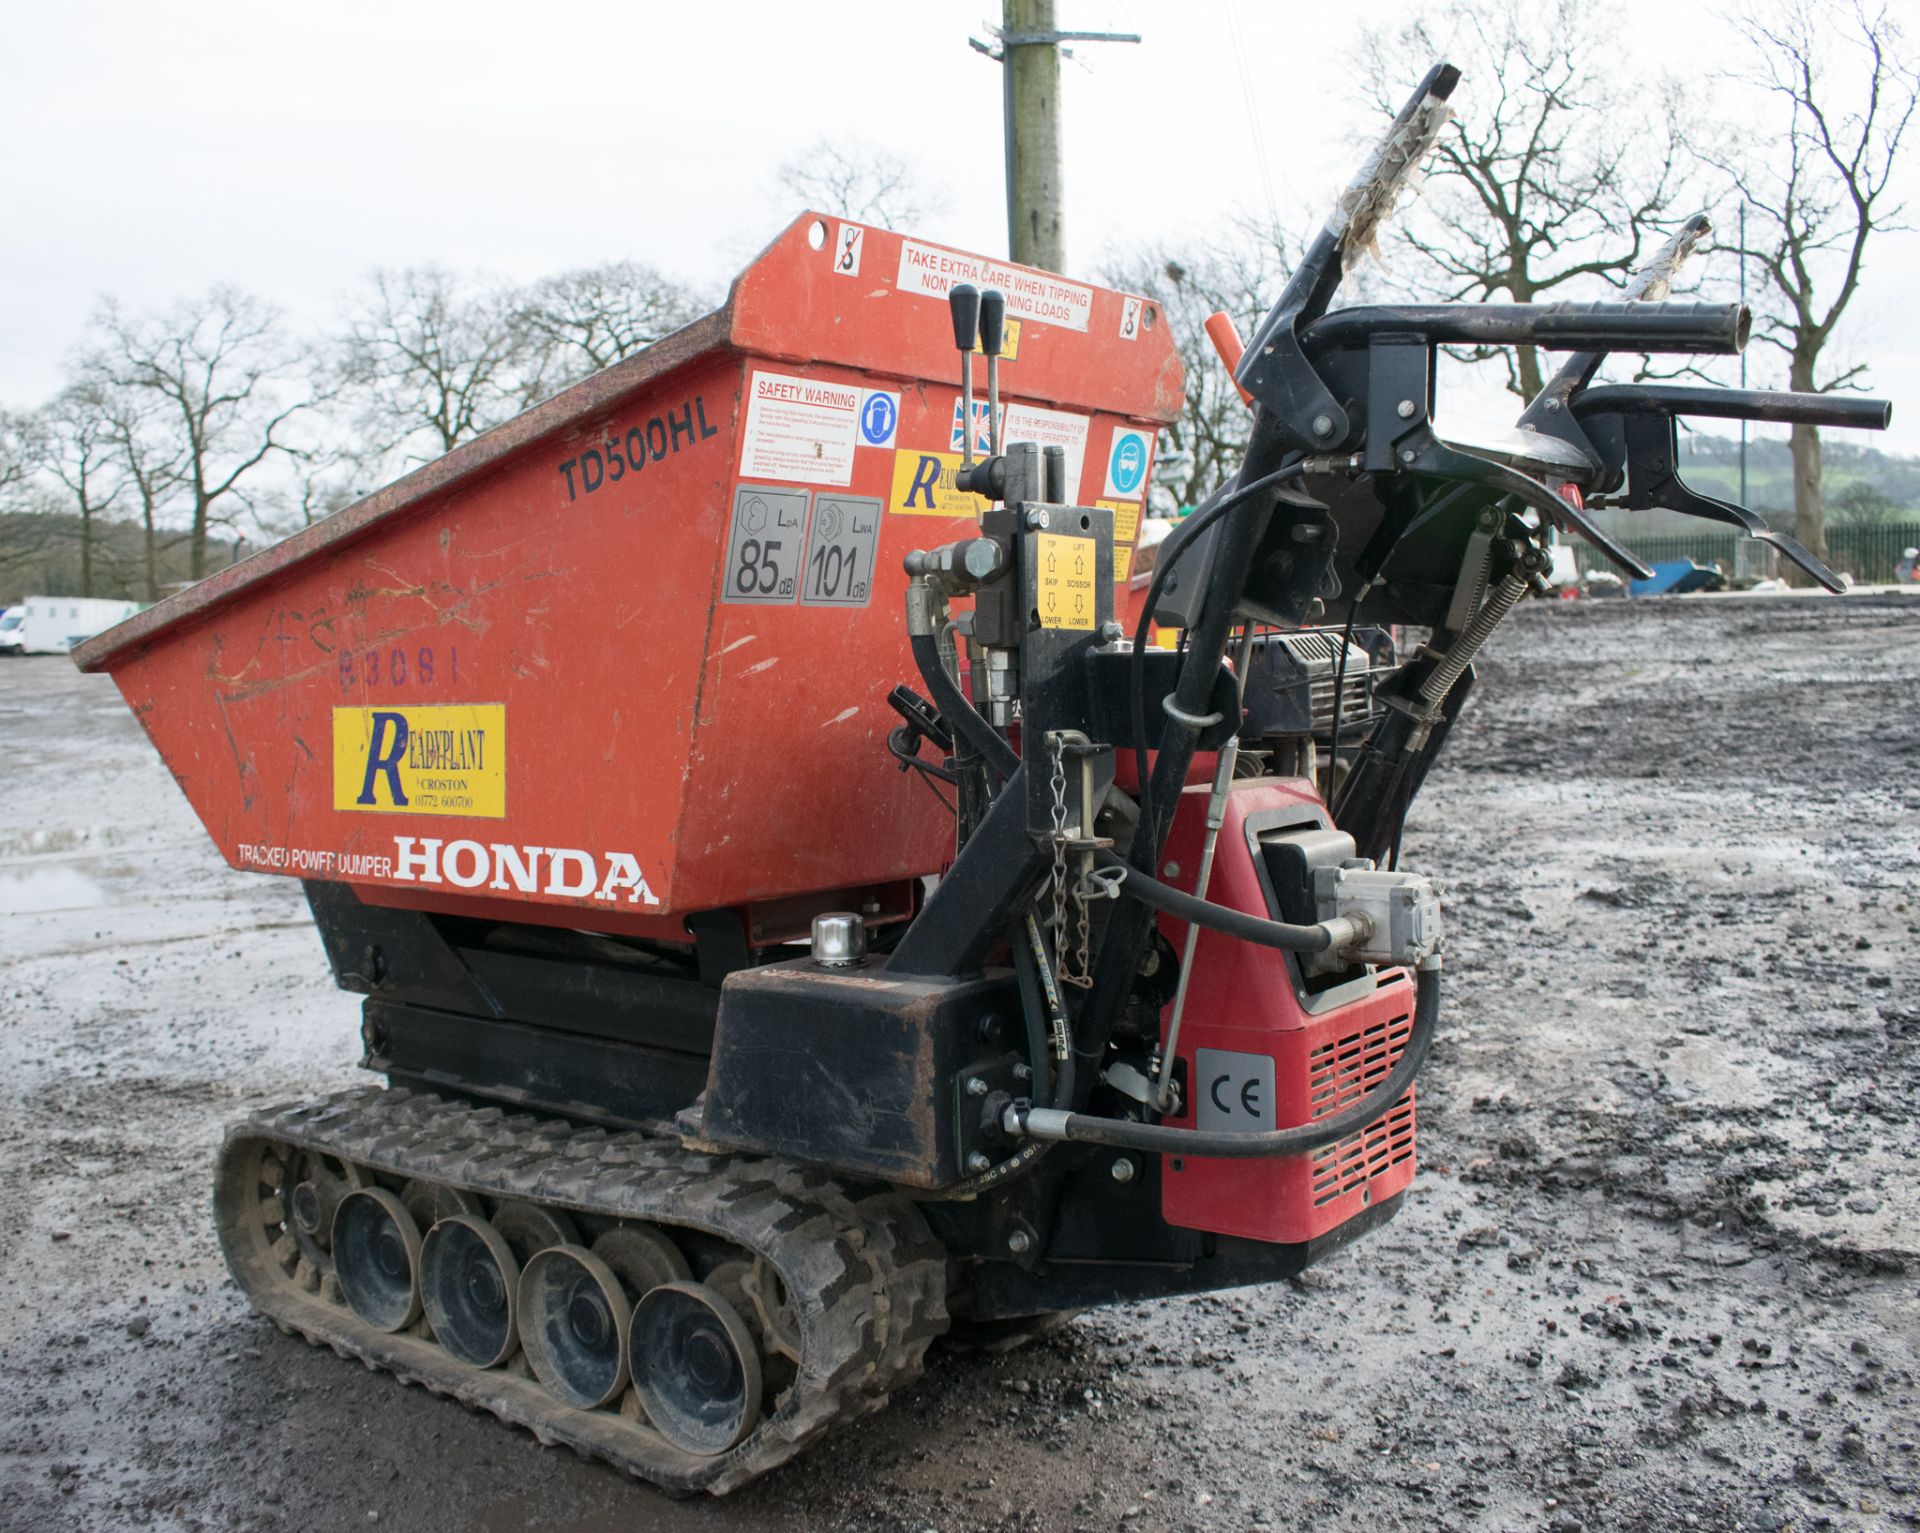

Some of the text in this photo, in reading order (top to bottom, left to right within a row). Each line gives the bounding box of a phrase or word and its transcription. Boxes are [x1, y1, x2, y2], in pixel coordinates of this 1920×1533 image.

[907, 249, 937, 270] TAKE
[940, 258, 977, 280] EXTRA
[981, 269, 1011, 288] CARE
[1015, 276, 1045, 296] WHEN
[1049, 286, 1087, 307] TIPPING
[922, 274, 948, 292] NON
[1004, 293, 1032, 312] NING
[1035, 303, 1070, 320] LOADS
[758, 381, 856, 408] SAFETY WARNING
[1008, 428, 1018, 437] THE
[1041, 432, 1070, 443] OPERATOR
[1022, 416, 1032, 426] THE
[1034, 418, 1077, 432] RESPONSIBILITY
[1078, 425, 1086, 434] OF
[558, 395, 718, 502] TD500HL
[736, 538, 793, 595] 85 dB
[812, 544, 866, 598] 101 dB
[1045, 578, 1058, 586] SKIP
[1067, 579, 1090, 589] SCISSOR
[1042, 616, 1062, 624] LOWER
[1069, 618, 1088, 626] LOWER
[421, 778, 468, 792] CROSTON
[415, 795, 473, 808] 01772 600700
[238, 844, 290, 868] TRACKED
[338, 853, 392, 878] DUMPER
[393, 835, 660, 905] HONDA
[1056, 1021, 1066, 1052] Parker
[1211, 1074, 1260, 1118] CE
